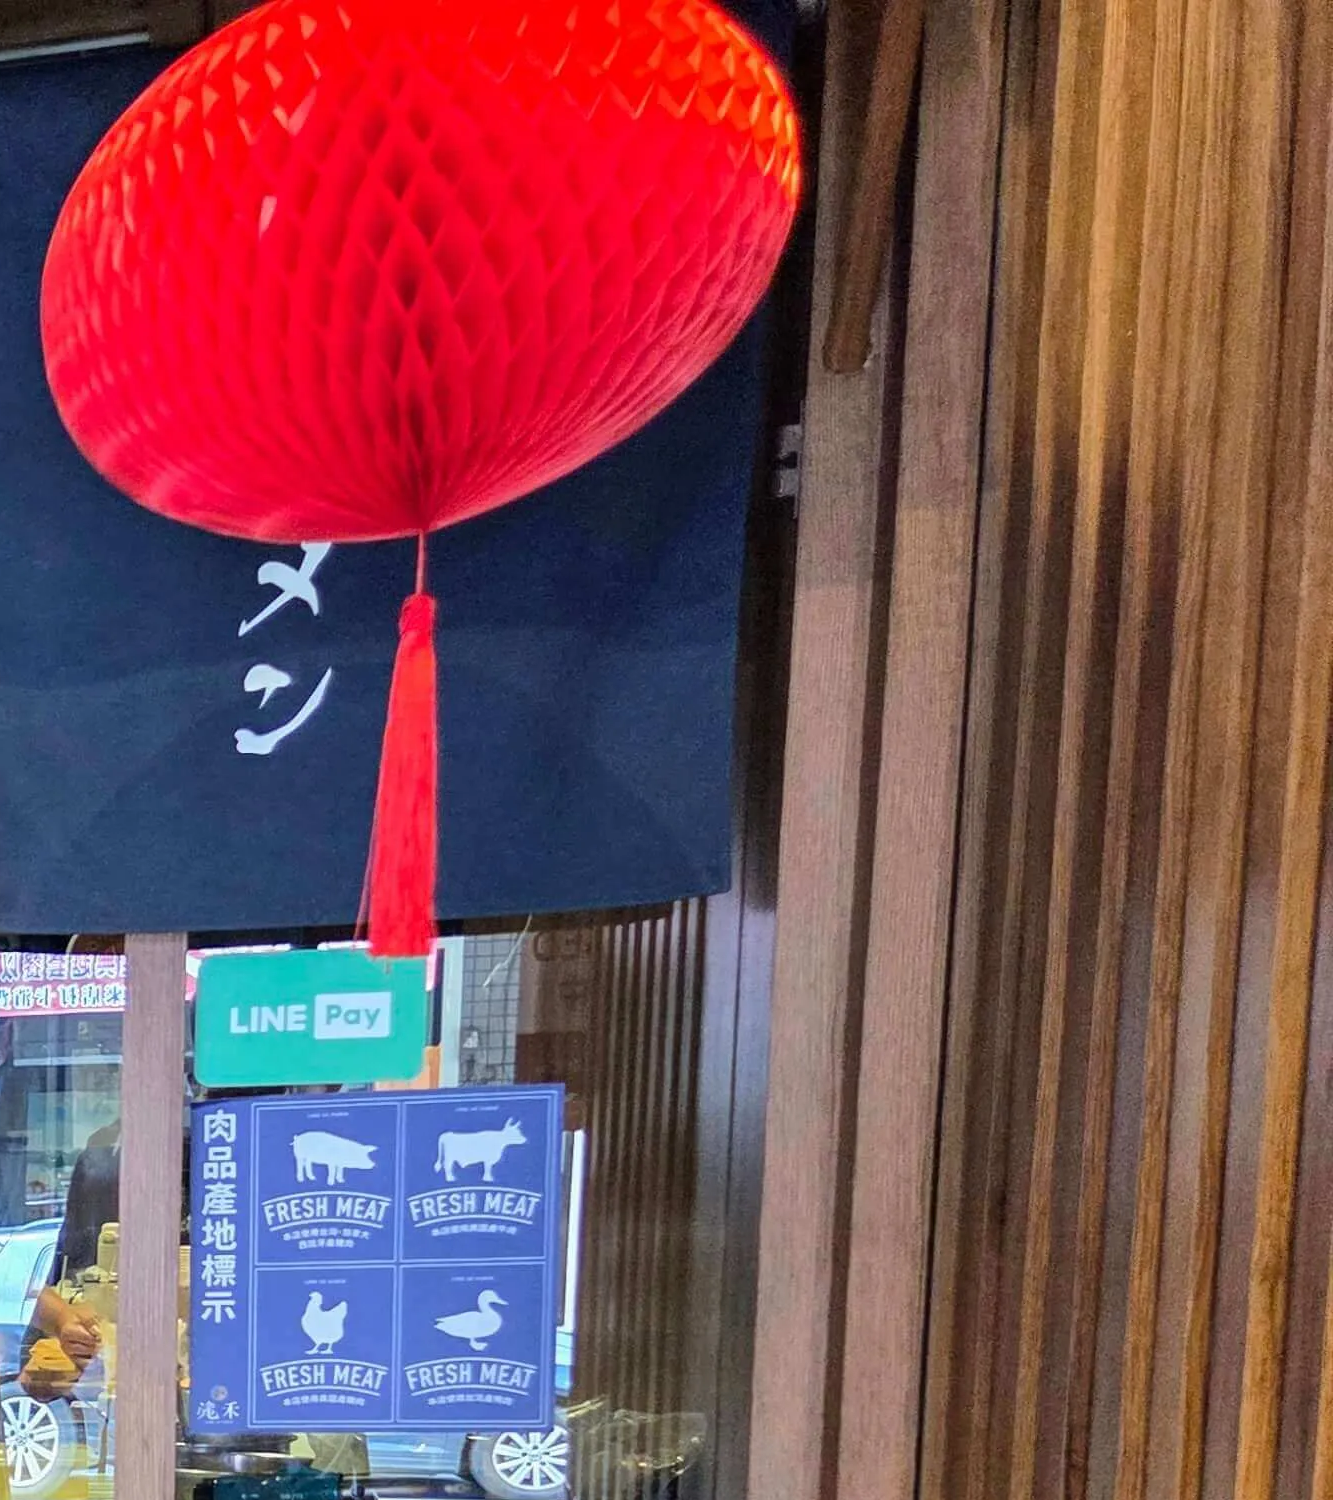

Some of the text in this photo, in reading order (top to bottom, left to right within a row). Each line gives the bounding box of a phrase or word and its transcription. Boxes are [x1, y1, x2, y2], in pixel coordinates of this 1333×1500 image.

[230, 1004, 381, 1034] LINE Pay
[201, 1108, 238, 1324] 肉品產地標示
[263, 1196, 391, 1226] FRESH MEAT
[408, 1193, 540, 1222] FRESH MEAT
[261, 1365, 388, 1392] FRESH MEAT
[404, 1363, 536, 1391] FRESH MEAT
